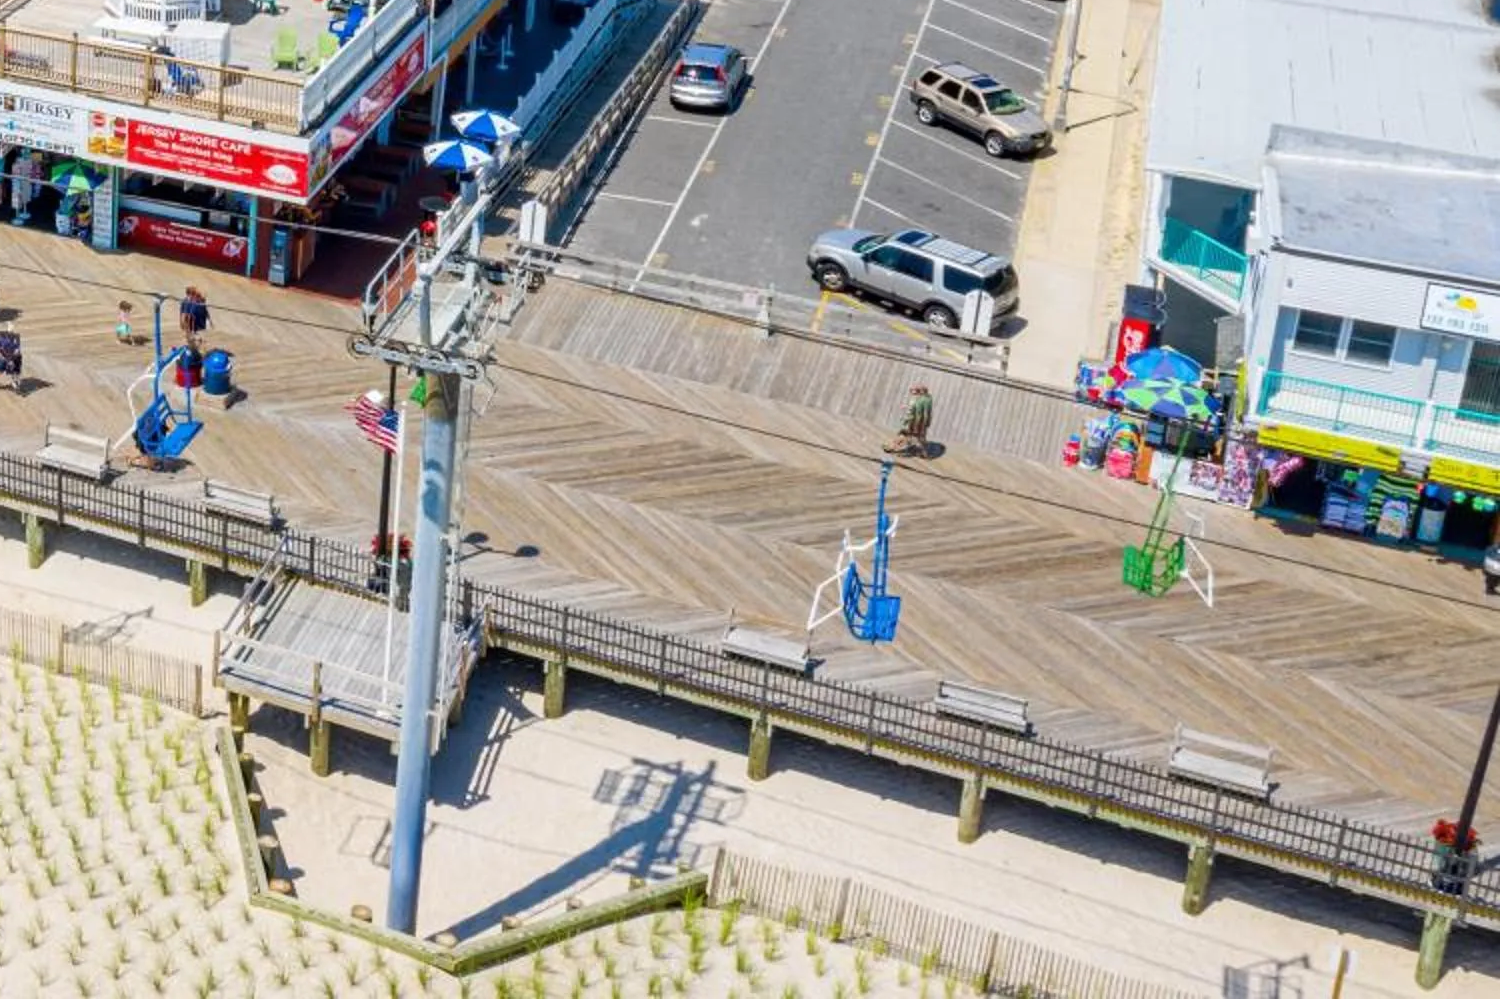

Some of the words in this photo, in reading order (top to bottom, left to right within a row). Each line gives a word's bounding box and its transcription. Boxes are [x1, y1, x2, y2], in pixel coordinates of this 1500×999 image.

[19, 96, 74, 120] JERSEY
[136, 124, 177, 140] JERSEY
[179, 132, 219, 148] SHORE
